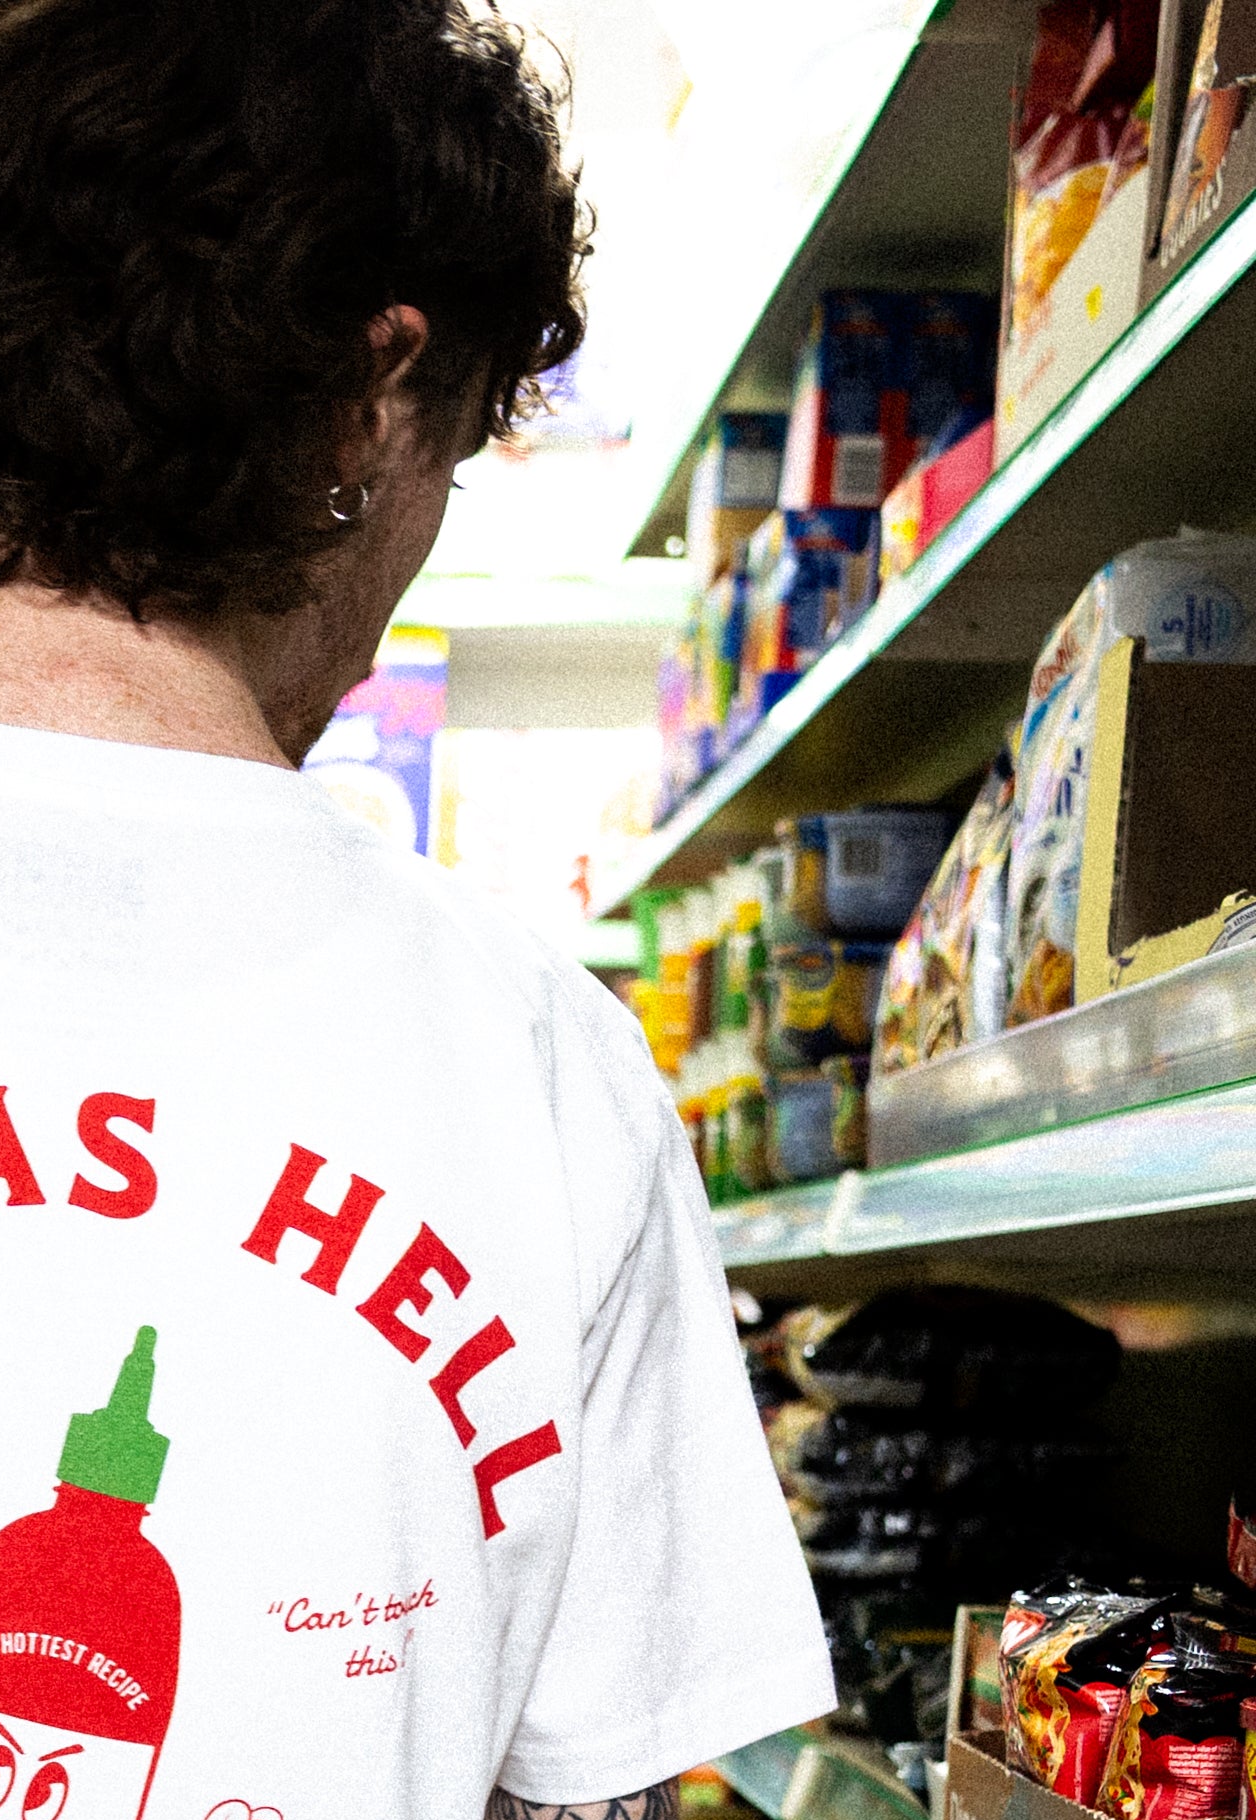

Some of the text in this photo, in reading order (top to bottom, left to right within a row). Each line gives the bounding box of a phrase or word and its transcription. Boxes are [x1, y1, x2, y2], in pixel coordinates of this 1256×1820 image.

[240, 1143, 562, 1540] HELL
[0, 1632, 89, 1665] HOTTEST
[87, 1653, 150, 1711] RECIPE
